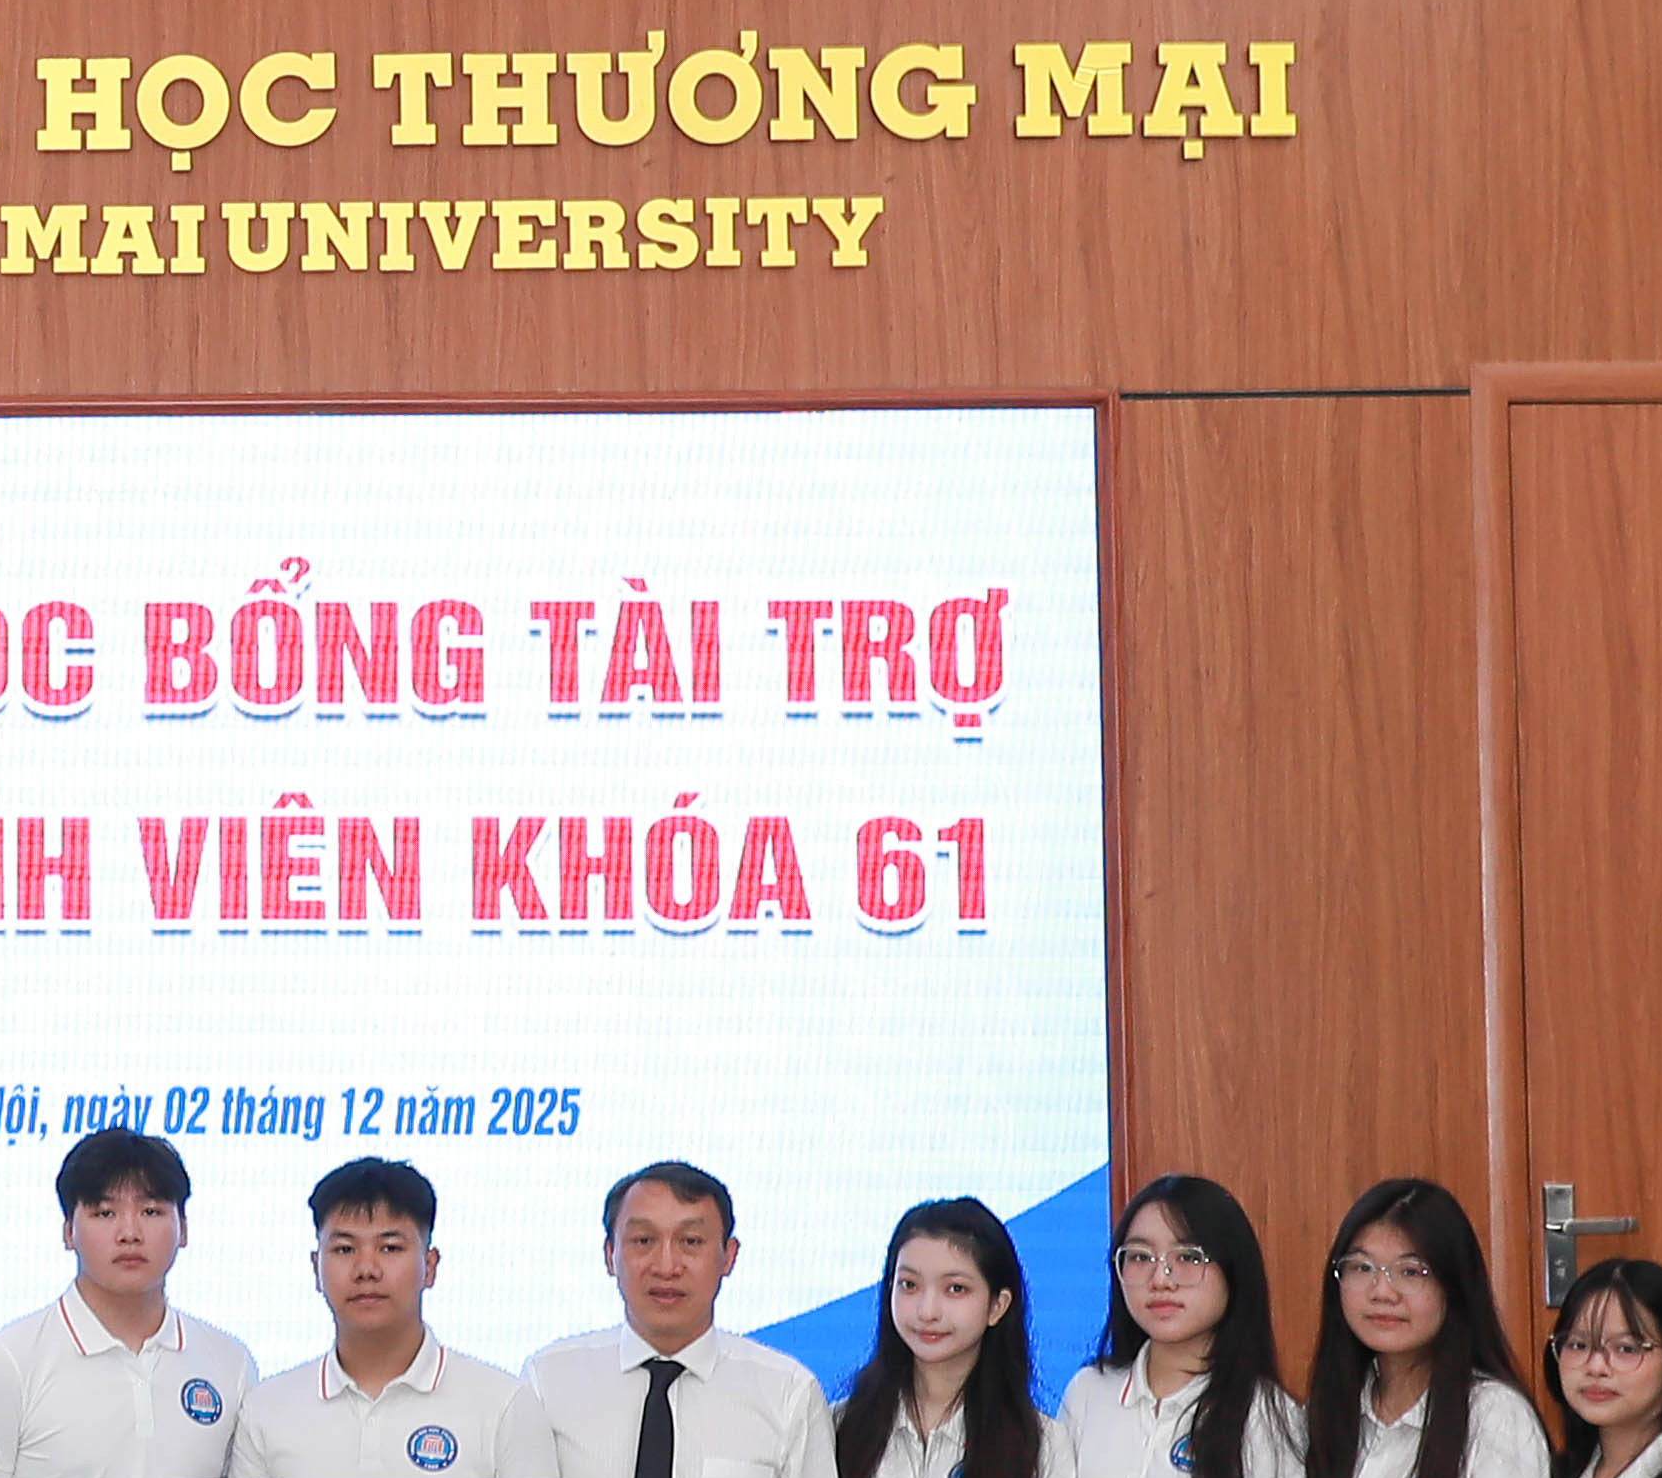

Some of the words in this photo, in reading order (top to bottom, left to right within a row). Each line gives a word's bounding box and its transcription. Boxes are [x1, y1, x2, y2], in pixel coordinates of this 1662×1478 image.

[37, 52, 337, 171] HỌC
[374, 30, 977, 145] THƯƠNG
[1014, 41, 1297, 159] MẠI
[222, 195, 884, 272] UNIVERSITY
[143, 557, 485, 719] BỔNG
[530, 578, 723, 717] TÀI
[768, 587, 1009, 734] TRỢ
[138, 793, 422, 928] VIÊN
[472, 793, 813, 928] KHÓA
[856, 816, 987, 928] 61
[62, 1084, 153, 1135] ngày
[163, 1085, 211, 1135] 02
[221, 1084, 326, 1141] tháng
[341, 1087, 385, 1136] 12
[395, 1085, 476, 1136] năm
[487, 1087, 581, 1136] 2025
